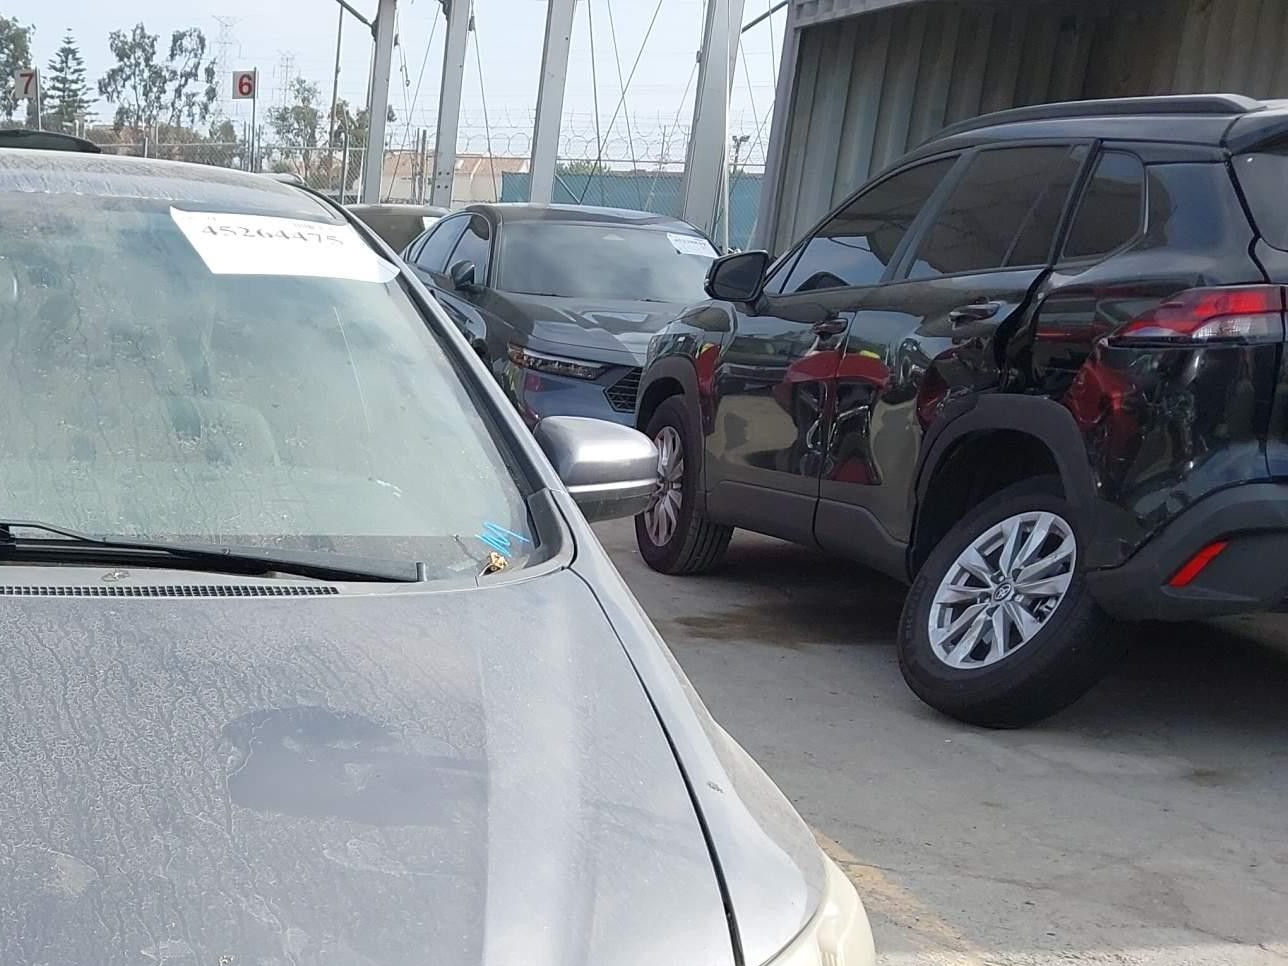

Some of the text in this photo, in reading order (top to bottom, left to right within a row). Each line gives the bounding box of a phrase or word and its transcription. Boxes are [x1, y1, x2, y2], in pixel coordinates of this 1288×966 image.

[20, 72, 34, 95] 7
[238, 73, 253, 96] 6
[201, 224, 344, 246] 45264475
